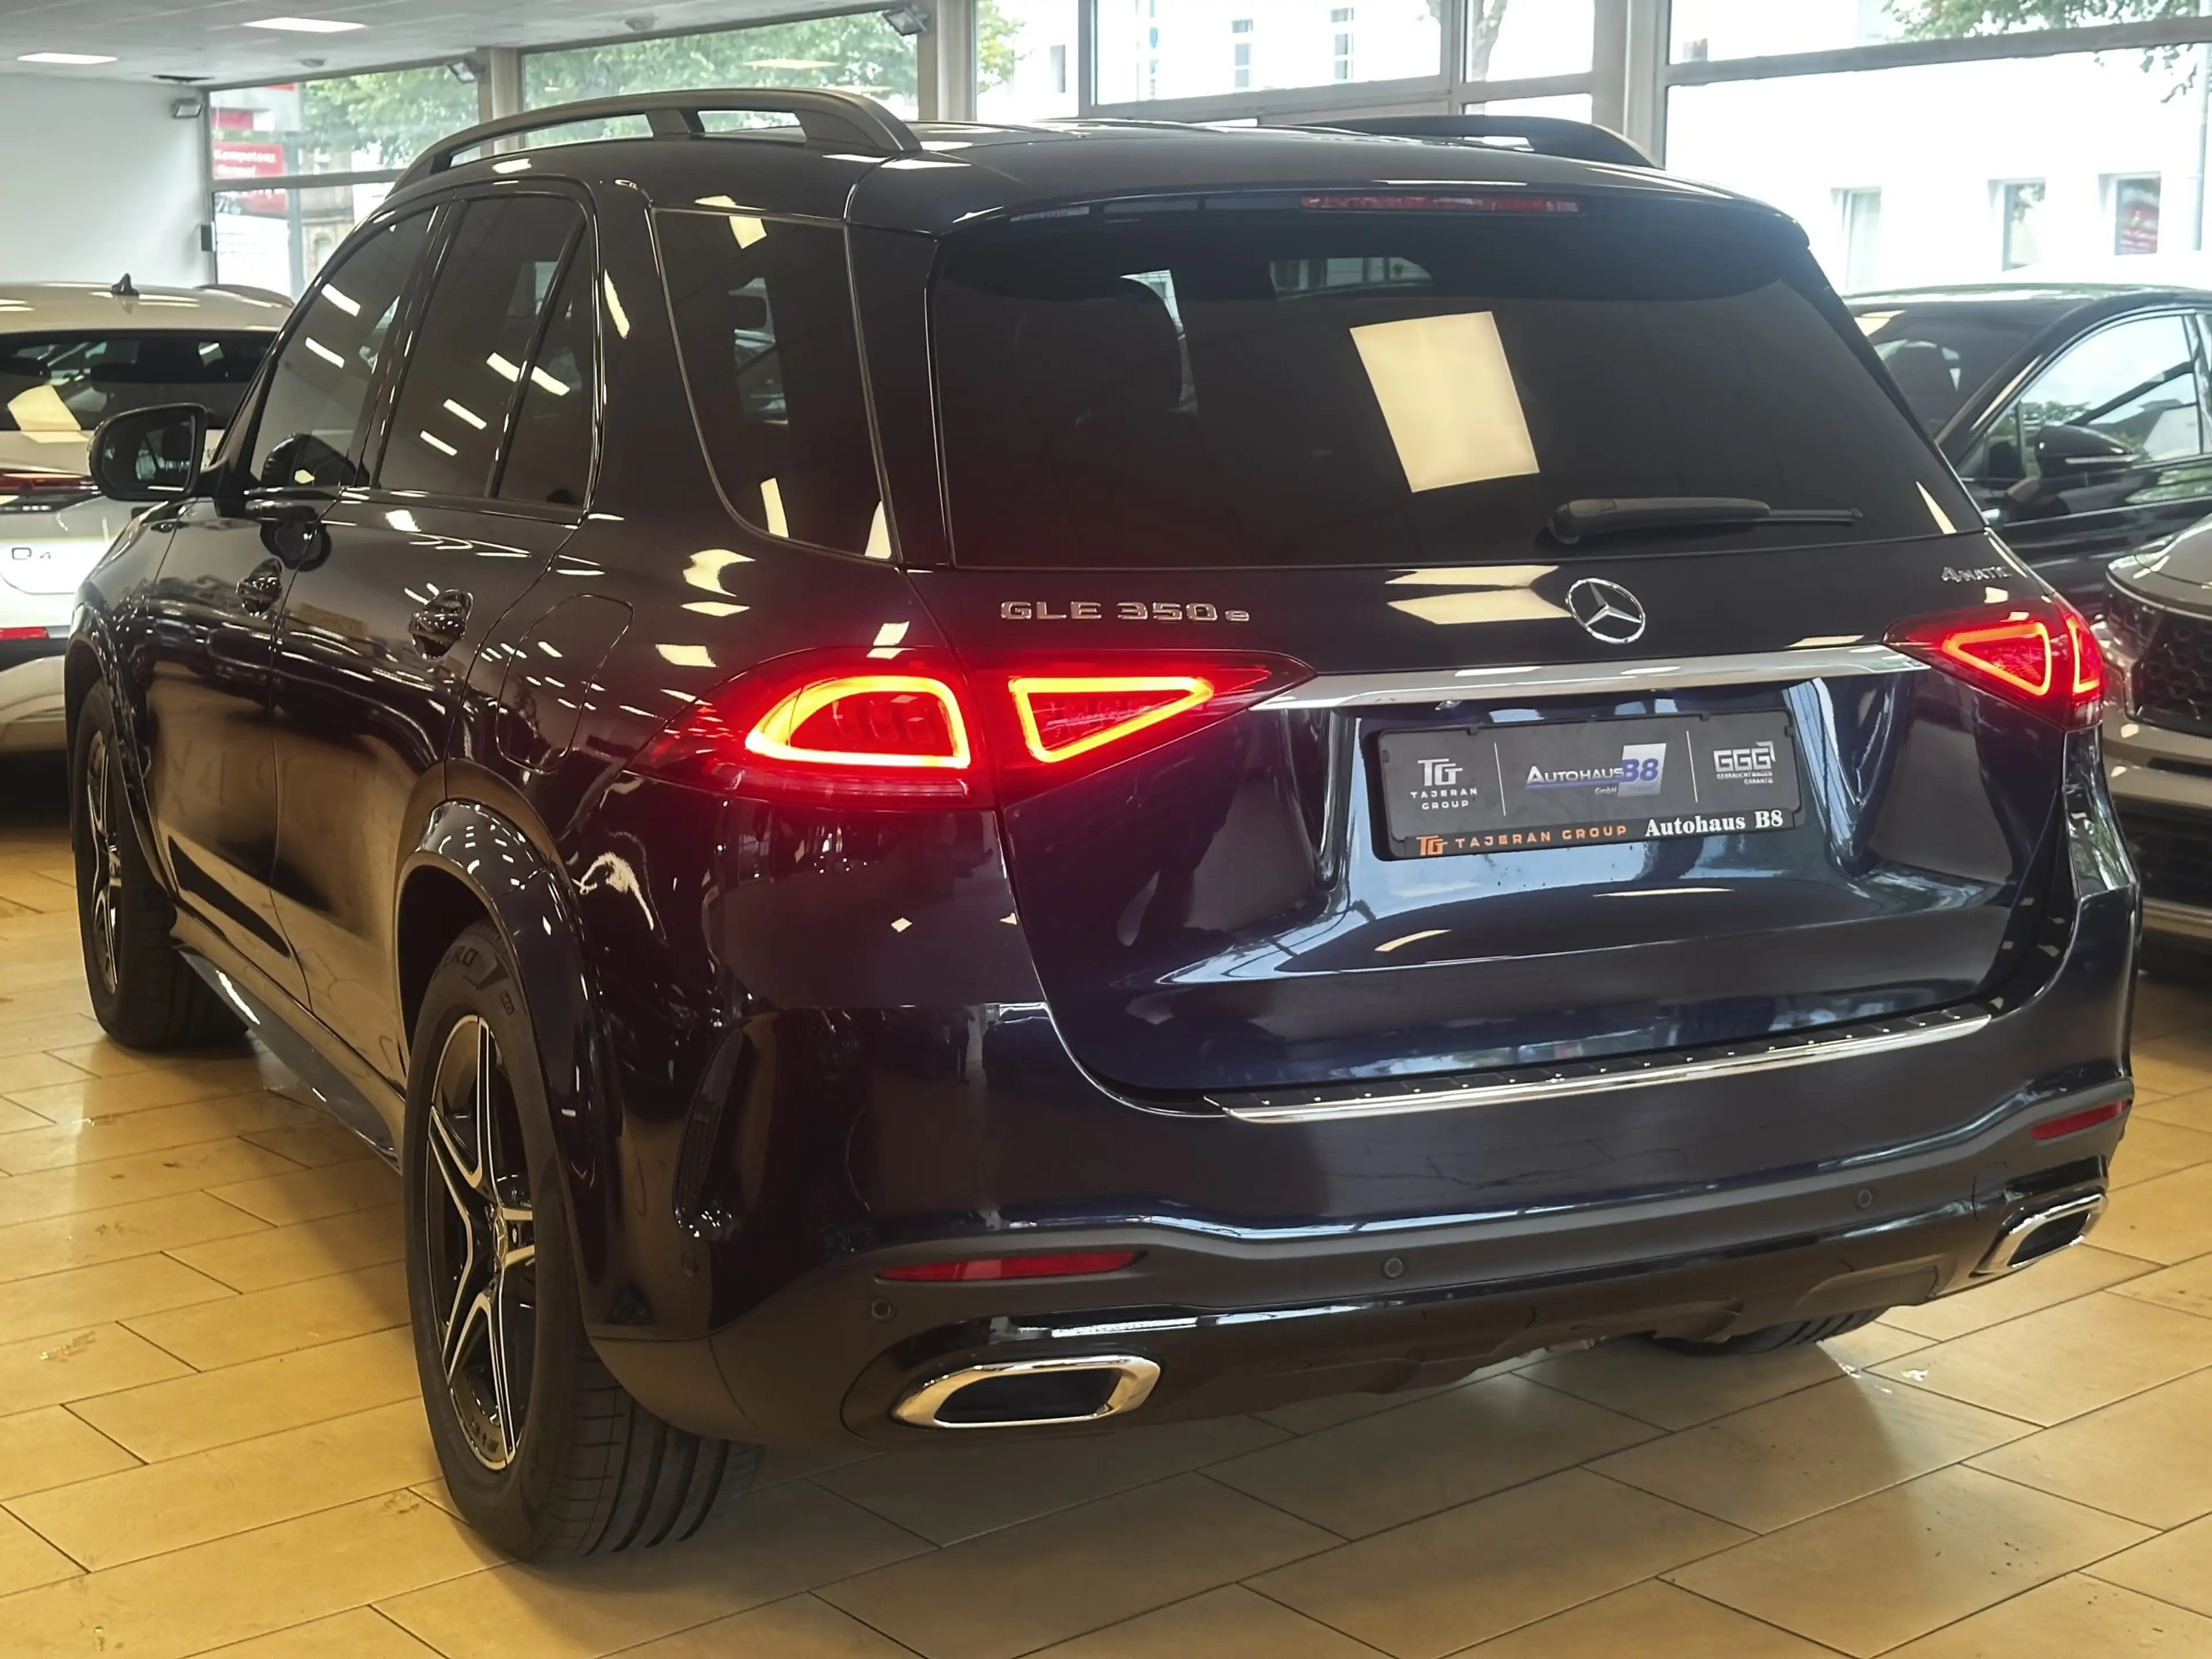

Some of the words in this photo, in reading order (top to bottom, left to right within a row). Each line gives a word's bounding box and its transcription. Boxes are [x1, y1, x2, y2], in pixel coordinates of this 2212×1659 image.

[1941, 566, 2012, 582] 4MATIC
[1001, 601, 1102, 620] GLE
[1714, 747, 1772, 772] GGG
[1417, 758, 1463, 786] TG
[1410, 787, 1478, 799] TAJERAN
[1594, 786, 1617, 796] GmbH
[1422, 800, 1469, 810] GROUP
[1645, 815, 1746, 837] Autohaus
[1754, 809, 1784, 829] B8
[1455, 831, 1551, 849] TAJERAN
[1562, 825, 1627, 840] GROUP
